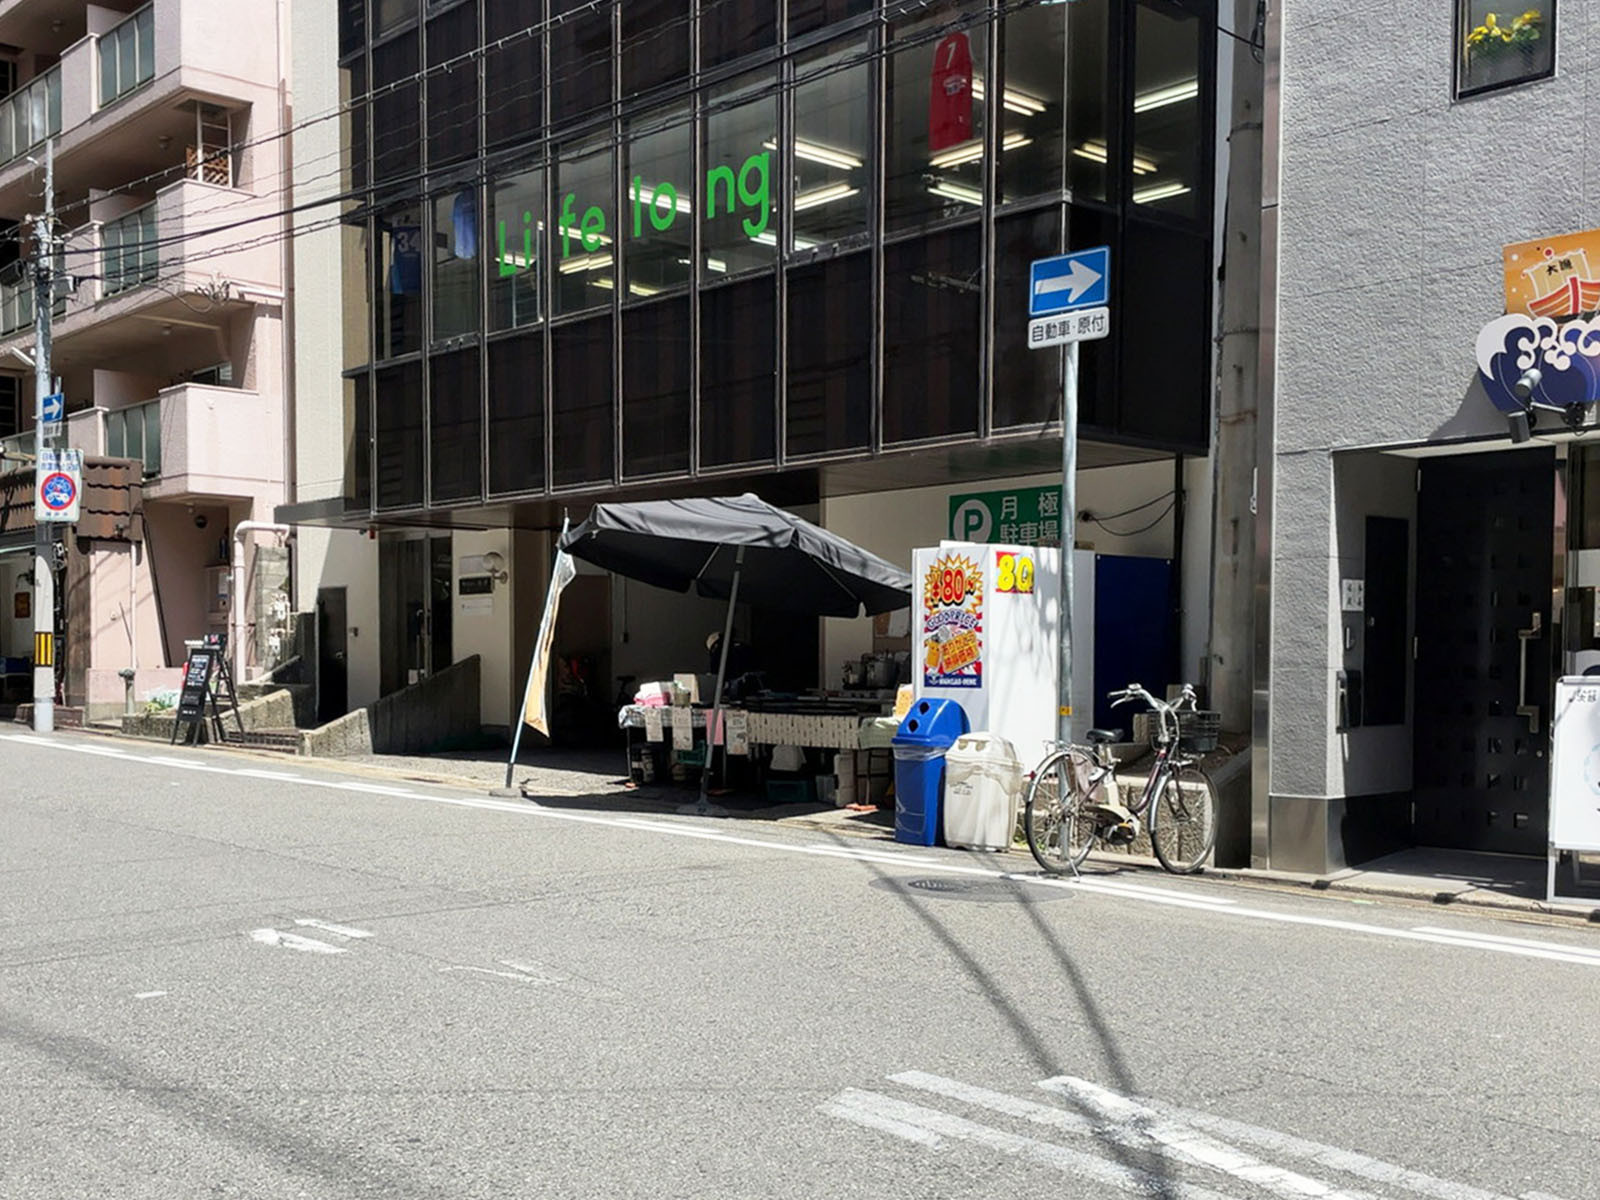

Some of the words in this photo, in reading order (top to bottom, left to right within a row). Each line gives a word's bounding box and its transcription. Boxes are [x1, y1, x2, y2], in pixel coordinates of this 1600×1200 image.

[964, 509, 984, 543] P
[1000, 520, 1060, 544] 駐車場
[997, 554, 1034, 593] 80
